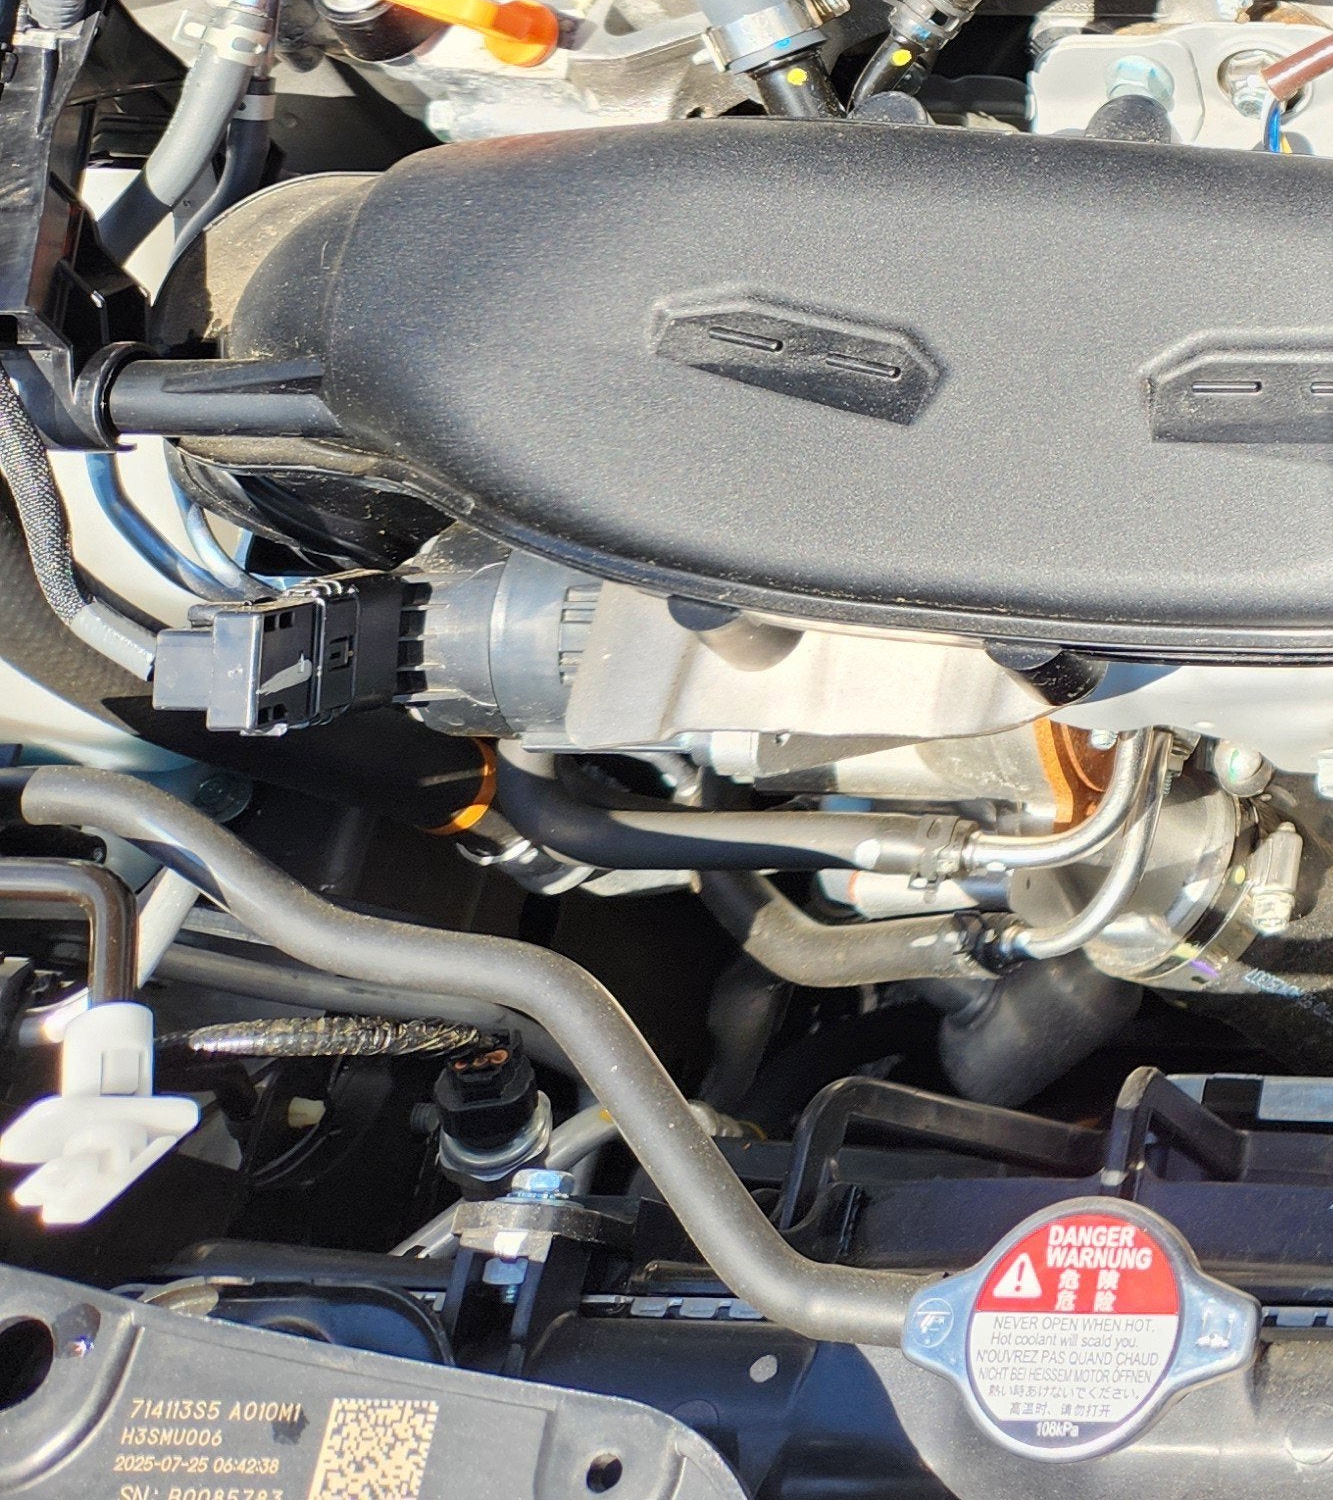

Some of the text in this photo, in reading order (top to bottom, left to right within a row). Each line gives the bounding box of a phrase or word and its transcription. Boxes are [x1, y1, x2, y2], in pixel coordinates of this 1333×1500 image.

[1050, 1225, 1136, 1247] DANGER
[1046, 1247, 1153, 1270] WARNUNG
[993, 1316, 1038, 1330] NEVER
[1042, 1316, 1079, 1331] OPEN
[1082, 1317, 1122, 1332] WHEN
[991, 1332, 1138, 1351] Hot coolant will scald you.
[1040, 1351, 1066, 1365] PAS
[1069, 1352, 1113, 1366] QUAND
[979, 1367, 1008, 1381] NICHT
[1010, 1367, 1027, 1382] BEI
[1029, 1367, 1072, 1383] HEISSEM
[1074, 1368, 1110, 1384] MOTOR
[130, 1398, 302, 1422] 714113S5 A010M1
[120, 1426, 223, 1447] H3SMU006
[1036, 1422, 1080, 1438] 108kPa
[113, 1454, 280, 1474] 2025-07-25 06:42:38
